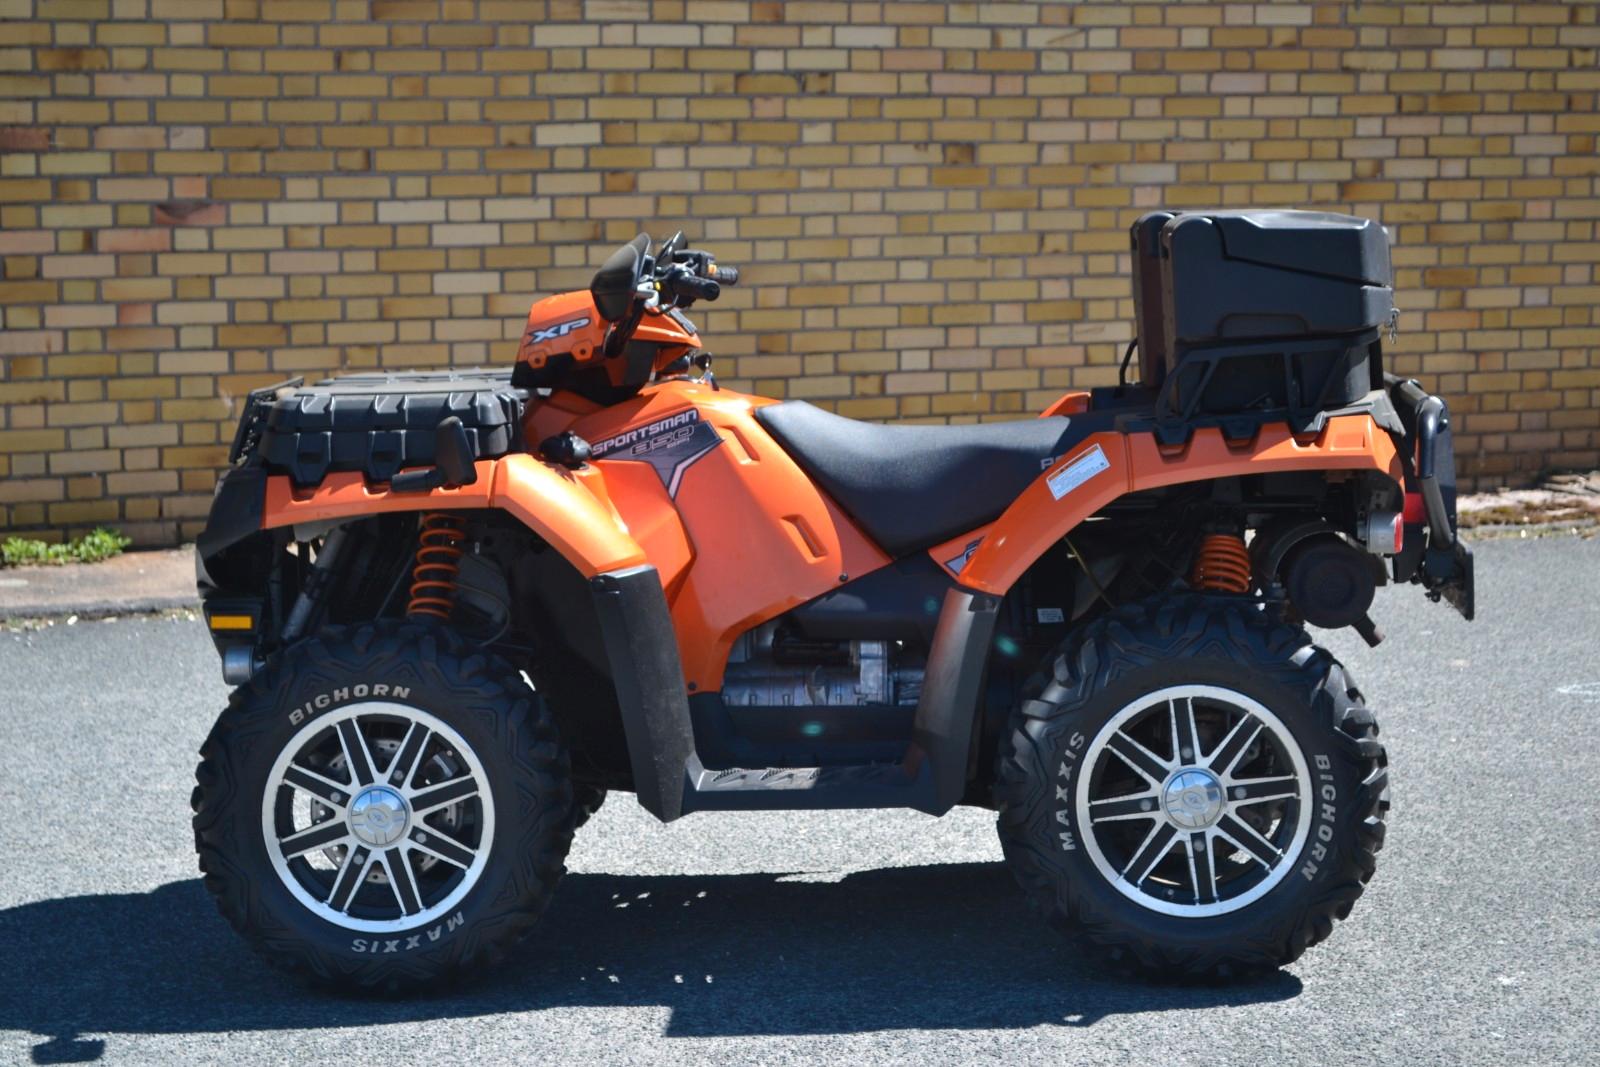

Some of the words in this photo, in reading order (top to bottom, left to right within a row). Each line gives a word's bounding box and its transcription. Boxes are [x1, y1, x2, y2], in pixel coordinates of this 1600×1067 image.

[528, 317, 591, 345] XP
[592, 408, 698, 456] SPORTSMAN
[288, 683, 411, 726] BIGHORN
[1054, 731, 1085, 851] MAXXIS
[1301, 754, 1337, 881] BIGHORN
[351, 911, 464, 954] MAXXIS
